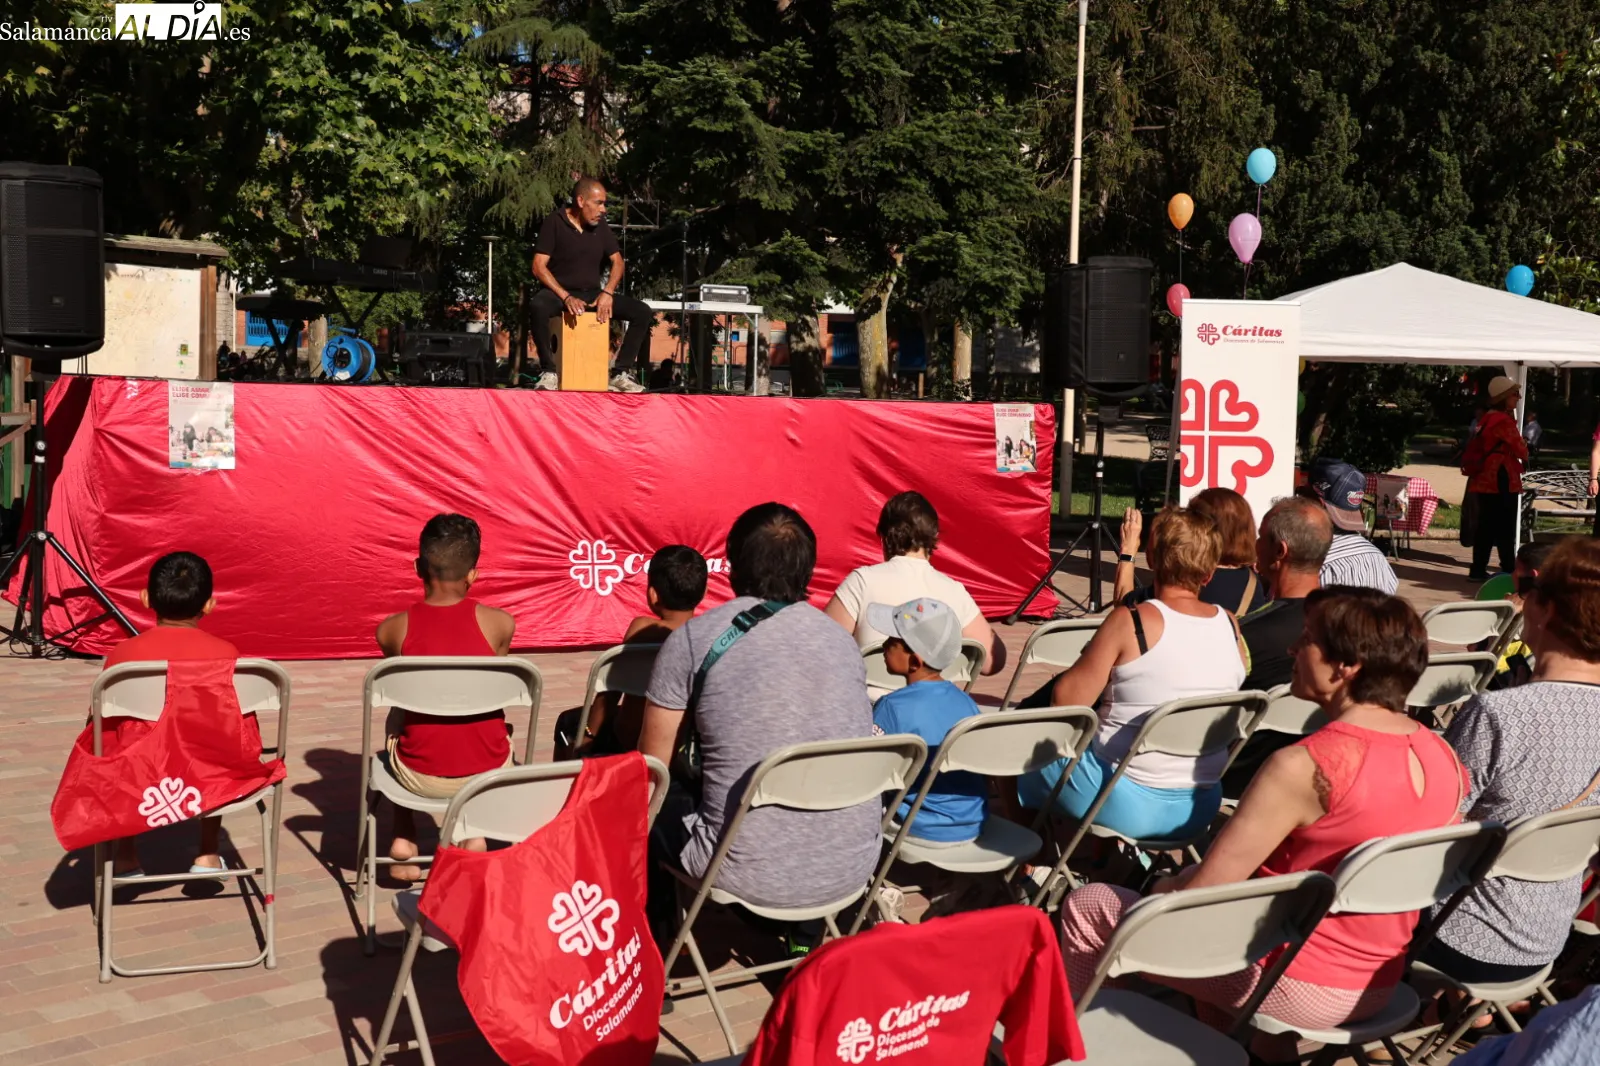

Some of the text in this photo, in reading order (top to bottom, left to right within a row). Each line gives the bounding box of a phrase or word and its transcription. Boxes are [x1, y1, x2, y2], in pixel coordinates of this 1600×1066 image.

[1222, 325, 1283, 337] Cáritas
[596, 982, 643, 1042] Salamanca
[879, 990, 971, 1032] Cáritas
